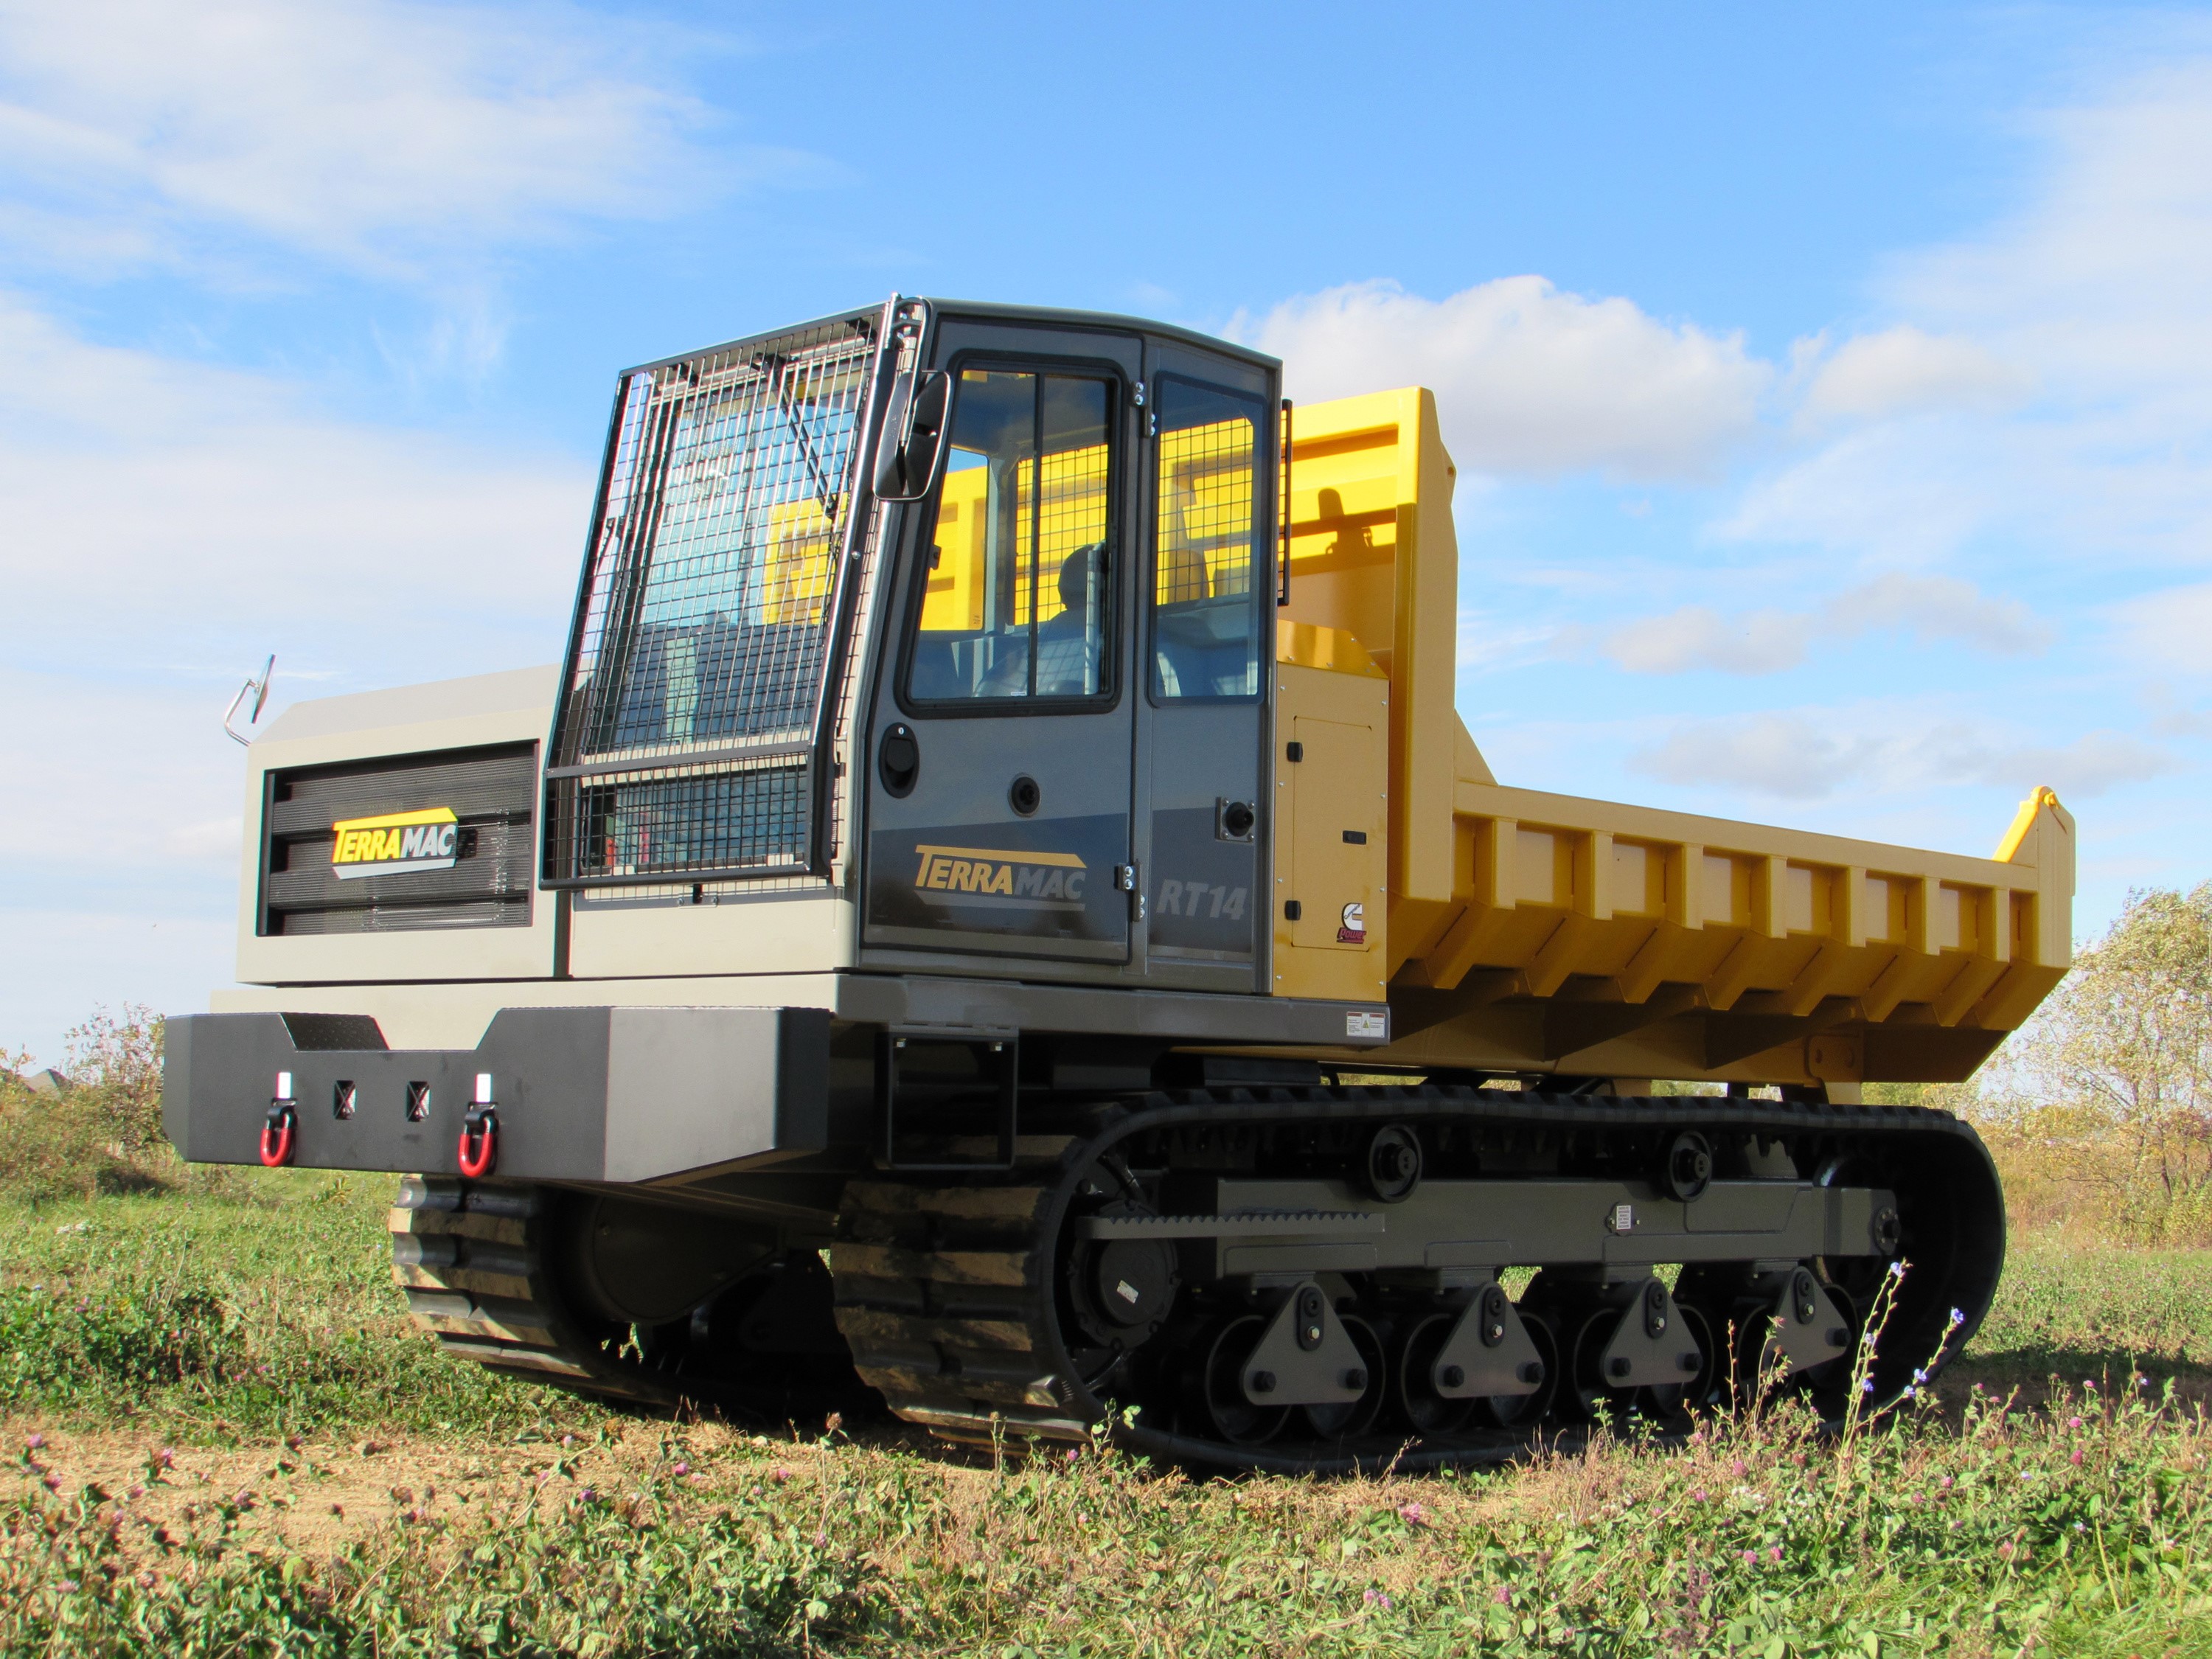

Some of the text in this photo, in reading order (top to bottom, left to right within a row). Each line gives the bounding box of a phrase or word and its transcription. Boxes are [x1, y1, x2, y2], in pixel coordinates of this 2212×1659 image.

[332, 807, 459, 863] TERRAMAC
[915, 844, 1087, 901] TERRAMAC
[1156, 879, 1248, 921] RT14
